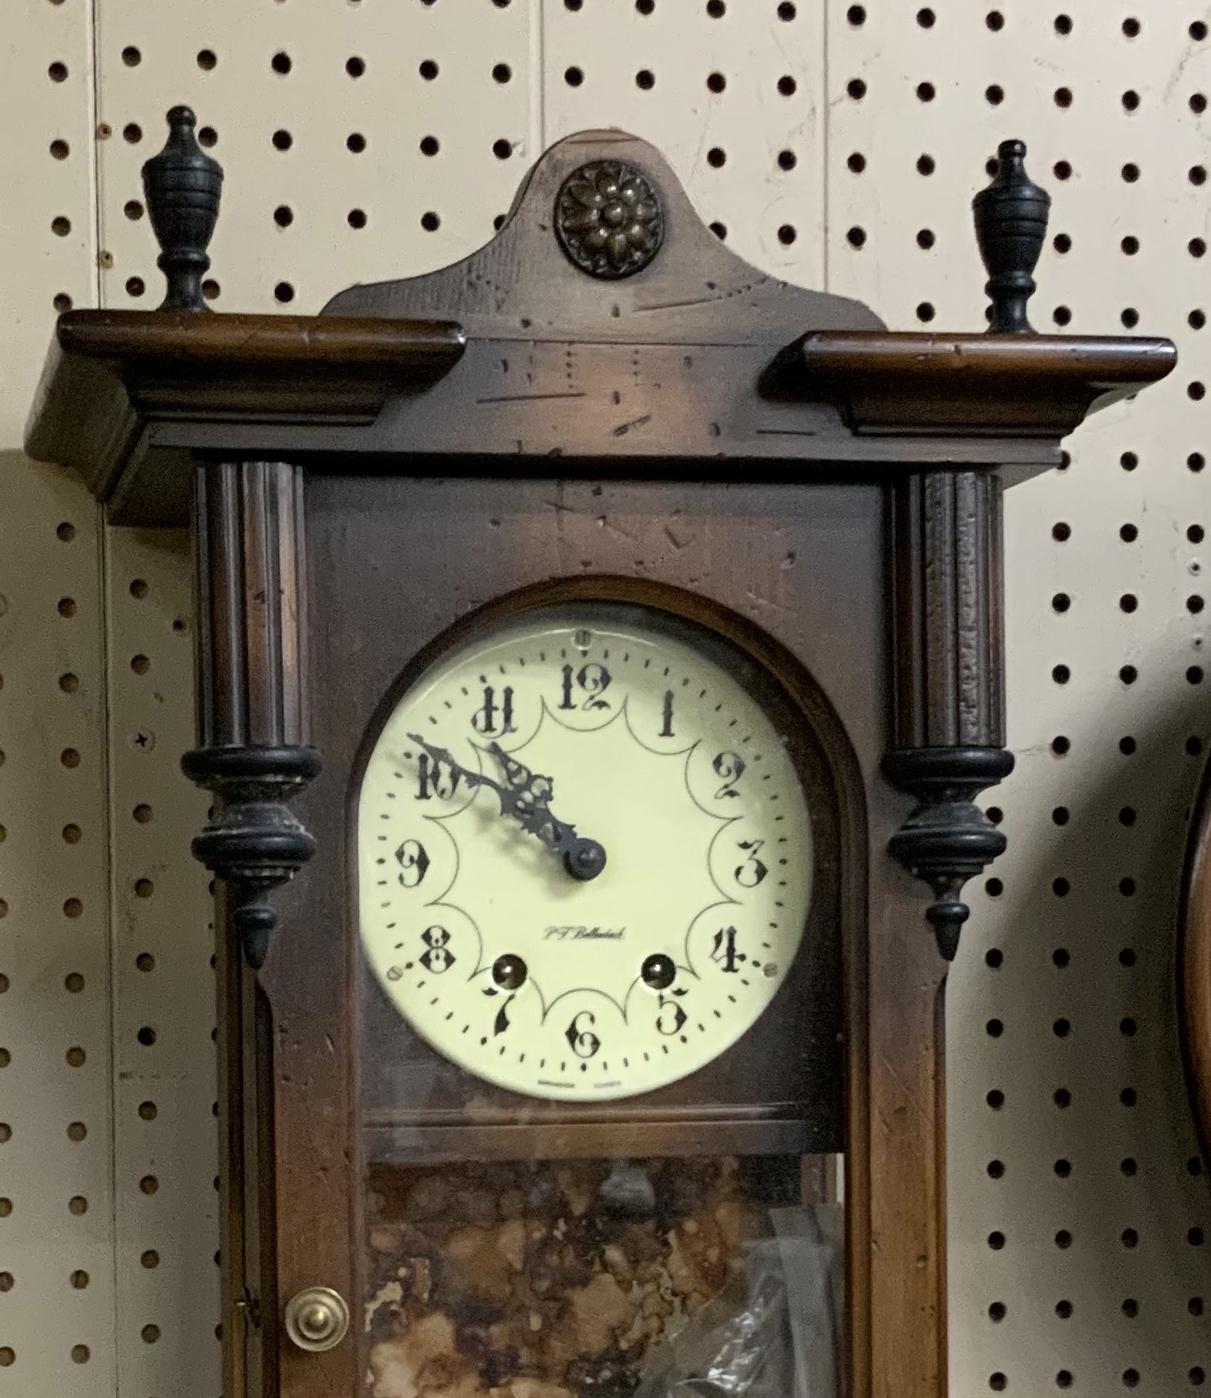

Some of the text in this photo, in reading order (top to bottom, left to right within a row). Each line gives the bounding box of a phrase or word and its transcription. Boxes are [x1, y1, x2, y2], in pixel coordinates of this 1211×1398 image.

[557, 662, 612, 710] 12
[471, 685, 518, 738] 11
[657, 689, 675, 738] 1
[414, 751, 461, 801] 10
[712, 751, 747, 799] 2
[395, 841, 431, 887] 9
[734, 839, 769, 887] 3
[418, 926, 456, 971] 8
[709, 926, 746, 973] 4
[481, 986, 516, 1038] 7
[564, 1013, 601, 1058] 6
[655, 986, 688, 1037] 5
